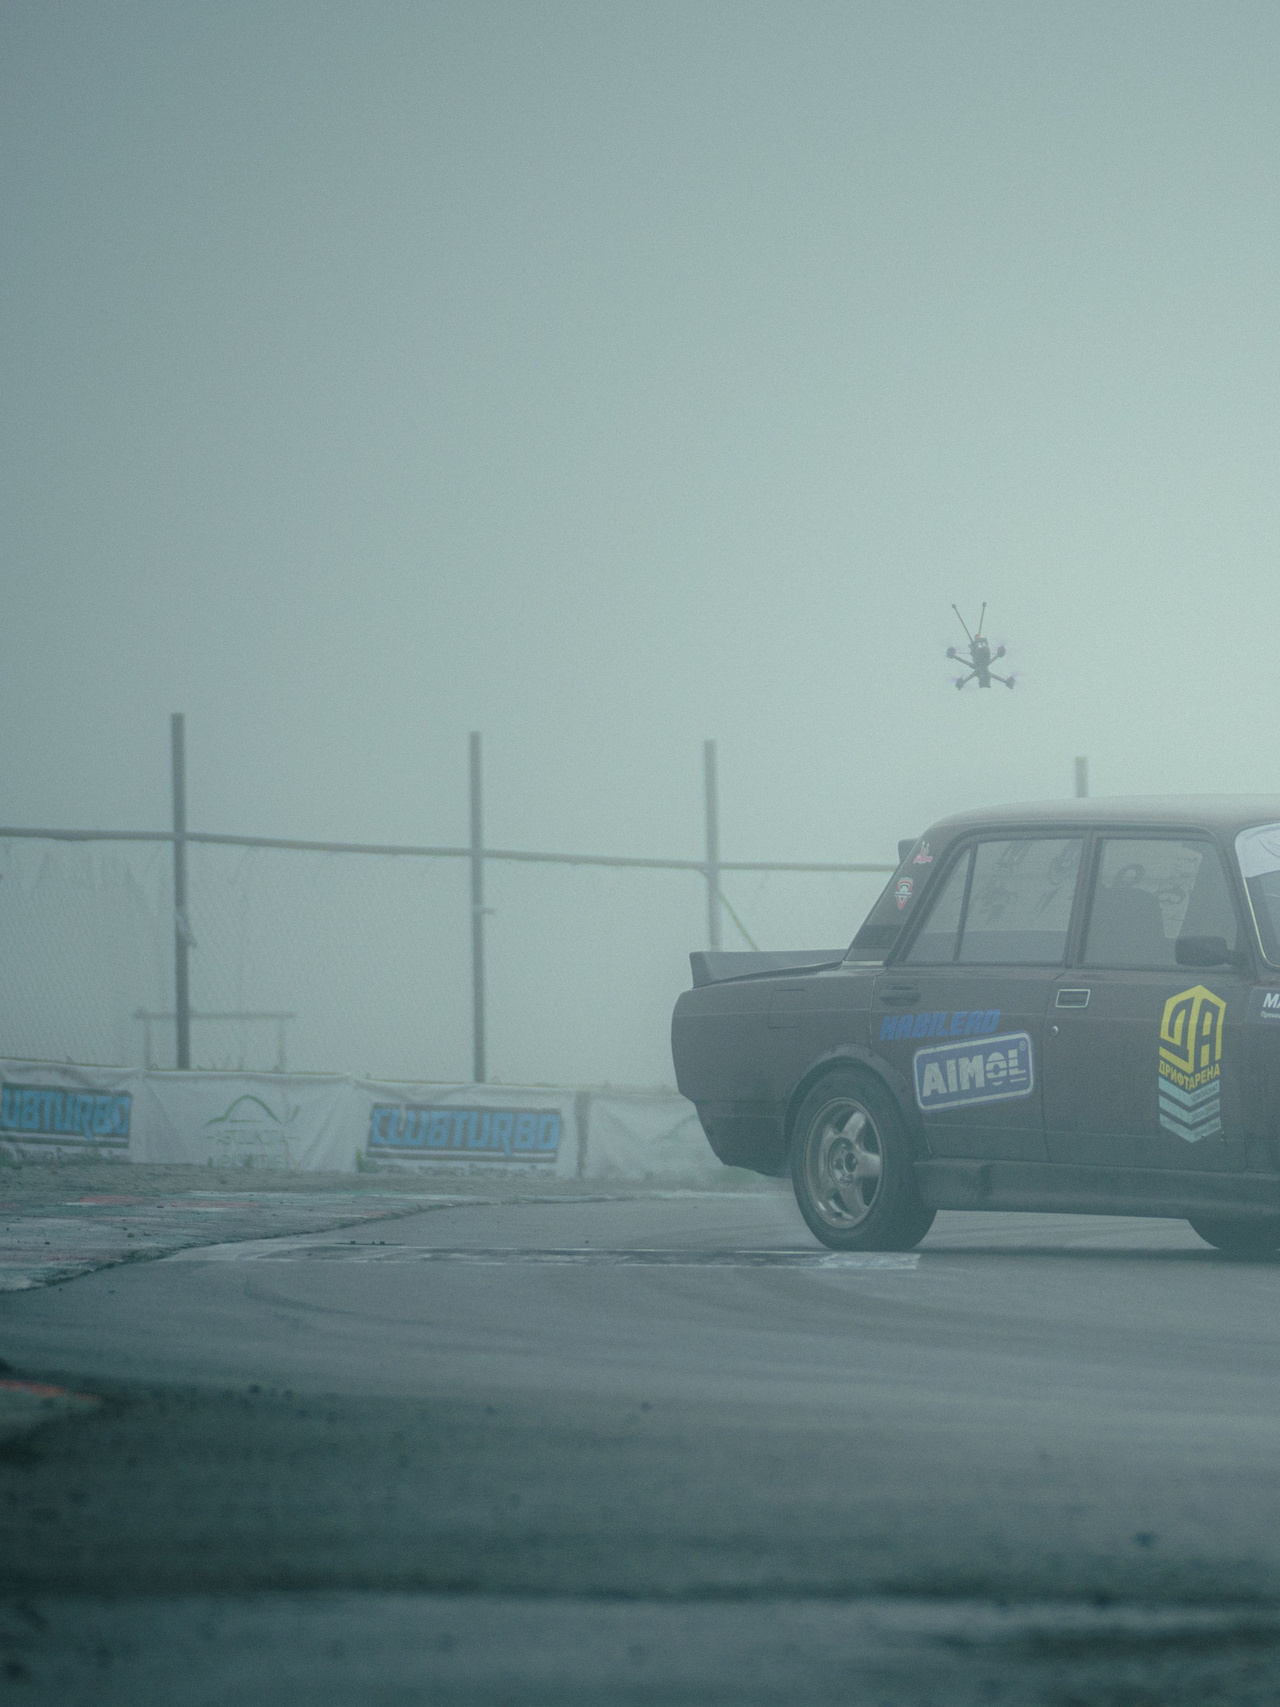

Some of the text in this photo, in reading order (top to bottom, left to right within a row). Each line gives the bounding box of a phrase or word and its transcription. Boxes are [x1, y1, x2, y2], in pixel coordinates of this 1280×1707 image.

[879, 1008, 1002, 1041] HABILEAD
[922, 1047, 1027, 1097] AIMOL
[1158, 1060, 1221, 1091] ДРИФТАРЕНА
[0, 1087, 132, 1142] UBTURBO
